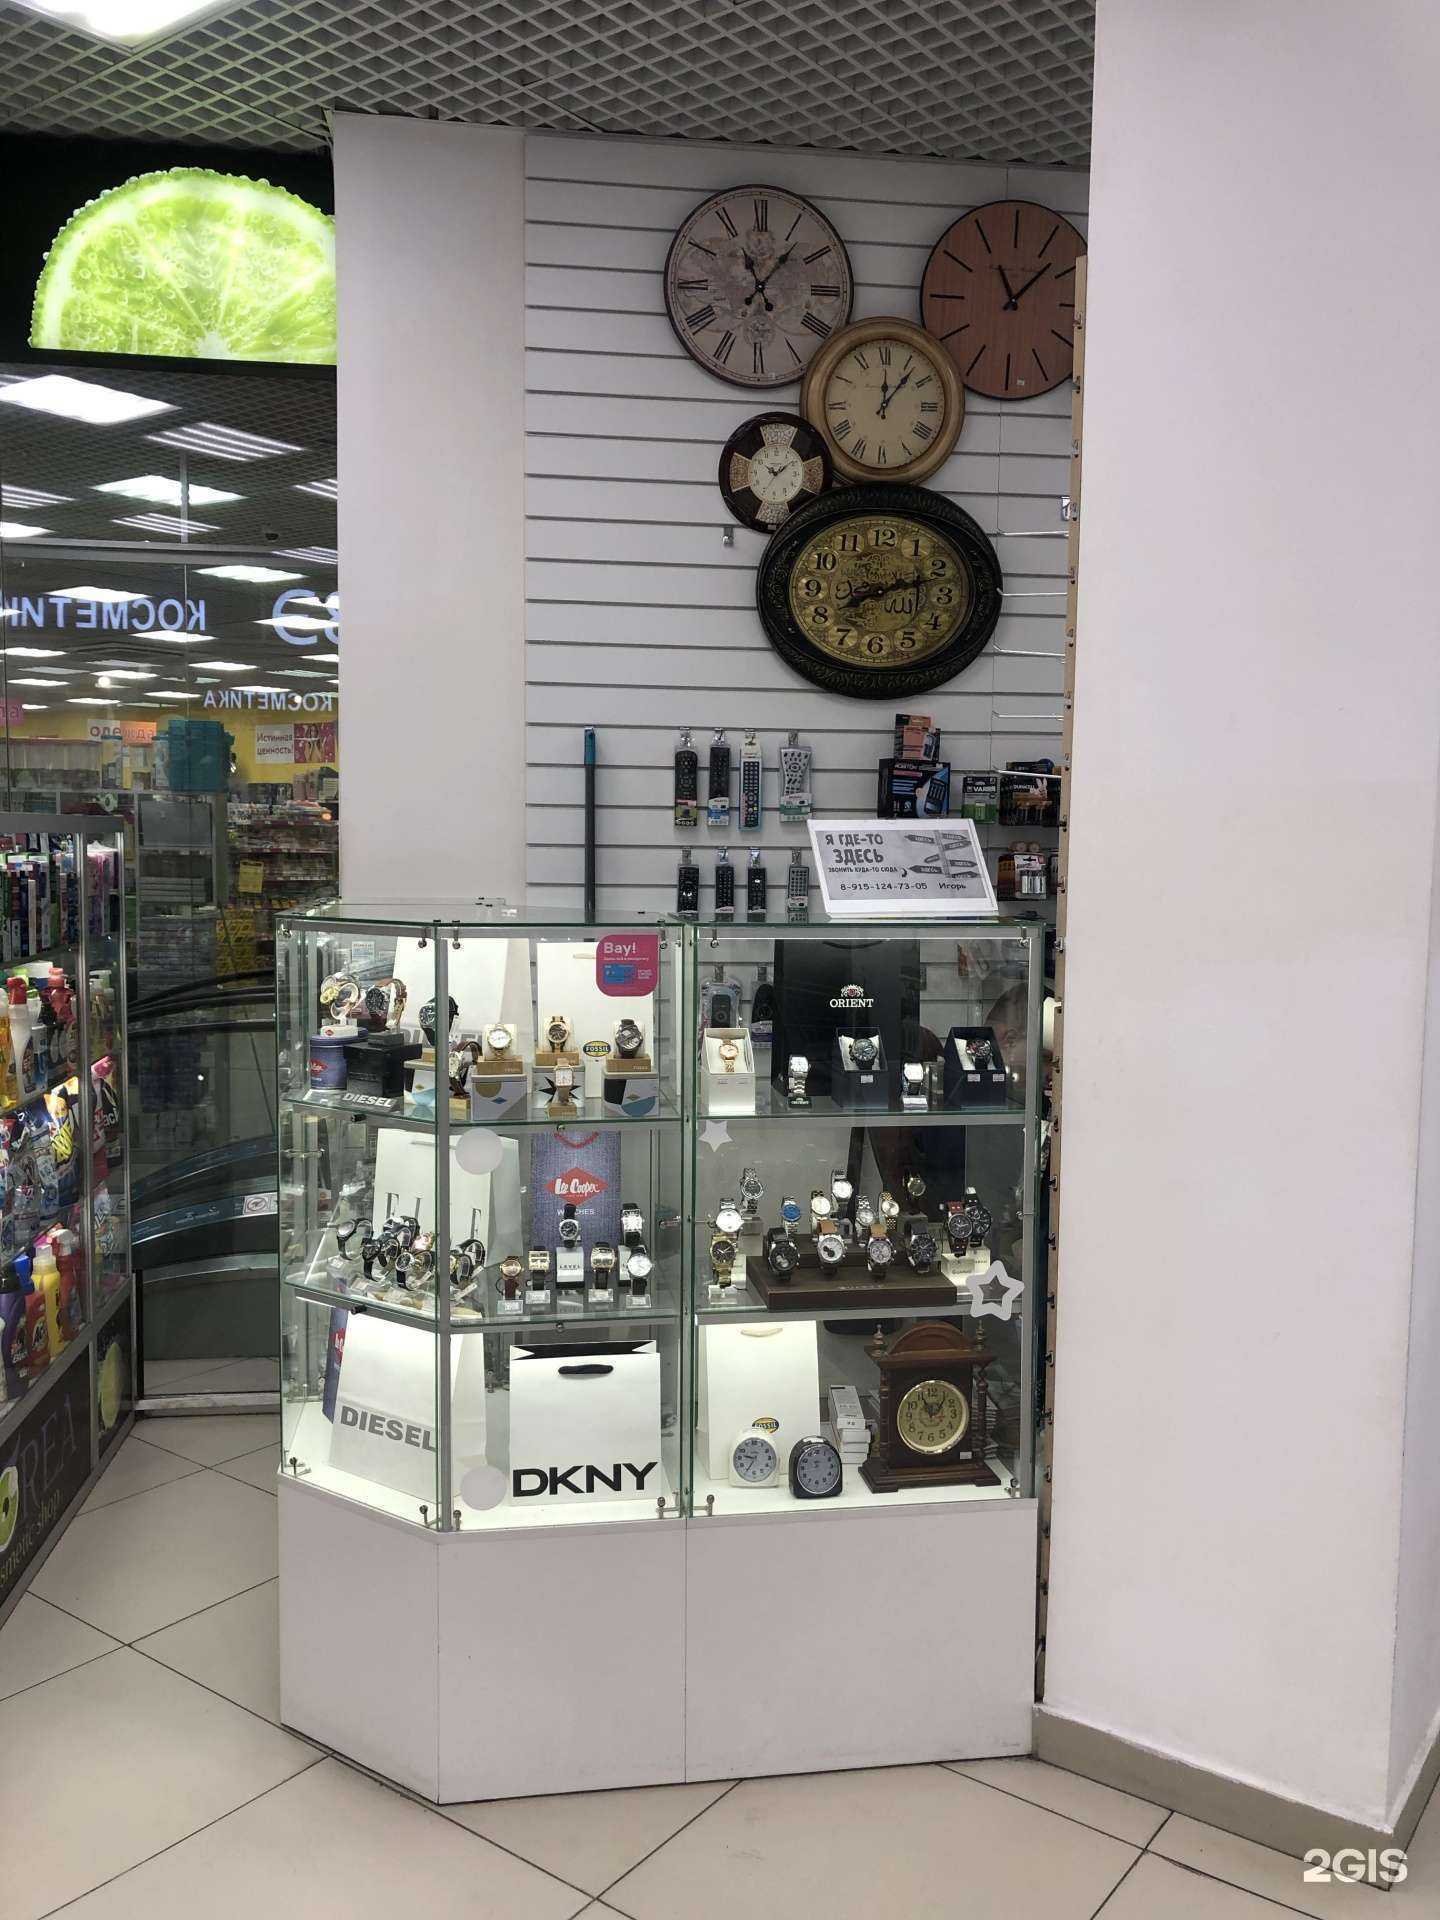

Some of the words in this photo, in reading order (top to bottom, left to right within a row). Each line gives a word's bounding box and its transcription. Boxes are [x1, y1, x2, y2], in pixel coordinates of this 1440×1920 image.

[840, 534, 858, 552] 11
[872, 528, 896, 547] 12
[912, 539, 921, 558] 1
[814, 552, 836, 571] 10
[930, 560, 947, 578] 2
[805, 579, 822, 597] 9
[936, 587, 953, 605] 3
[812, 606, 829, 624] 8
[924, 612, 942, 631] 4
[835, 628, 852, 646] 7
[867, 636, 883, 655] 6
[900, 631, 916, 649] 5
[825, 834, 834, 845] Я
[839, 834, 883, 846] ГДЕ-ТО
[833, 849, 884, 865] ЗДЕСЬ
[840, 883, 928, 891] 8-915-124-73-05
[938, 882, 966, 891] Игорь
[829, 998, 874, 1008] ORIENT
[342, 1092, 393, 1108] DIESEL
[555, 1178, 569, 1195] Lee
[570, 1178, 601, 1197] Cooper
[340, 1405, 437, 1453] DIESEL
[512, 1461, 659, 1498] DKNY
